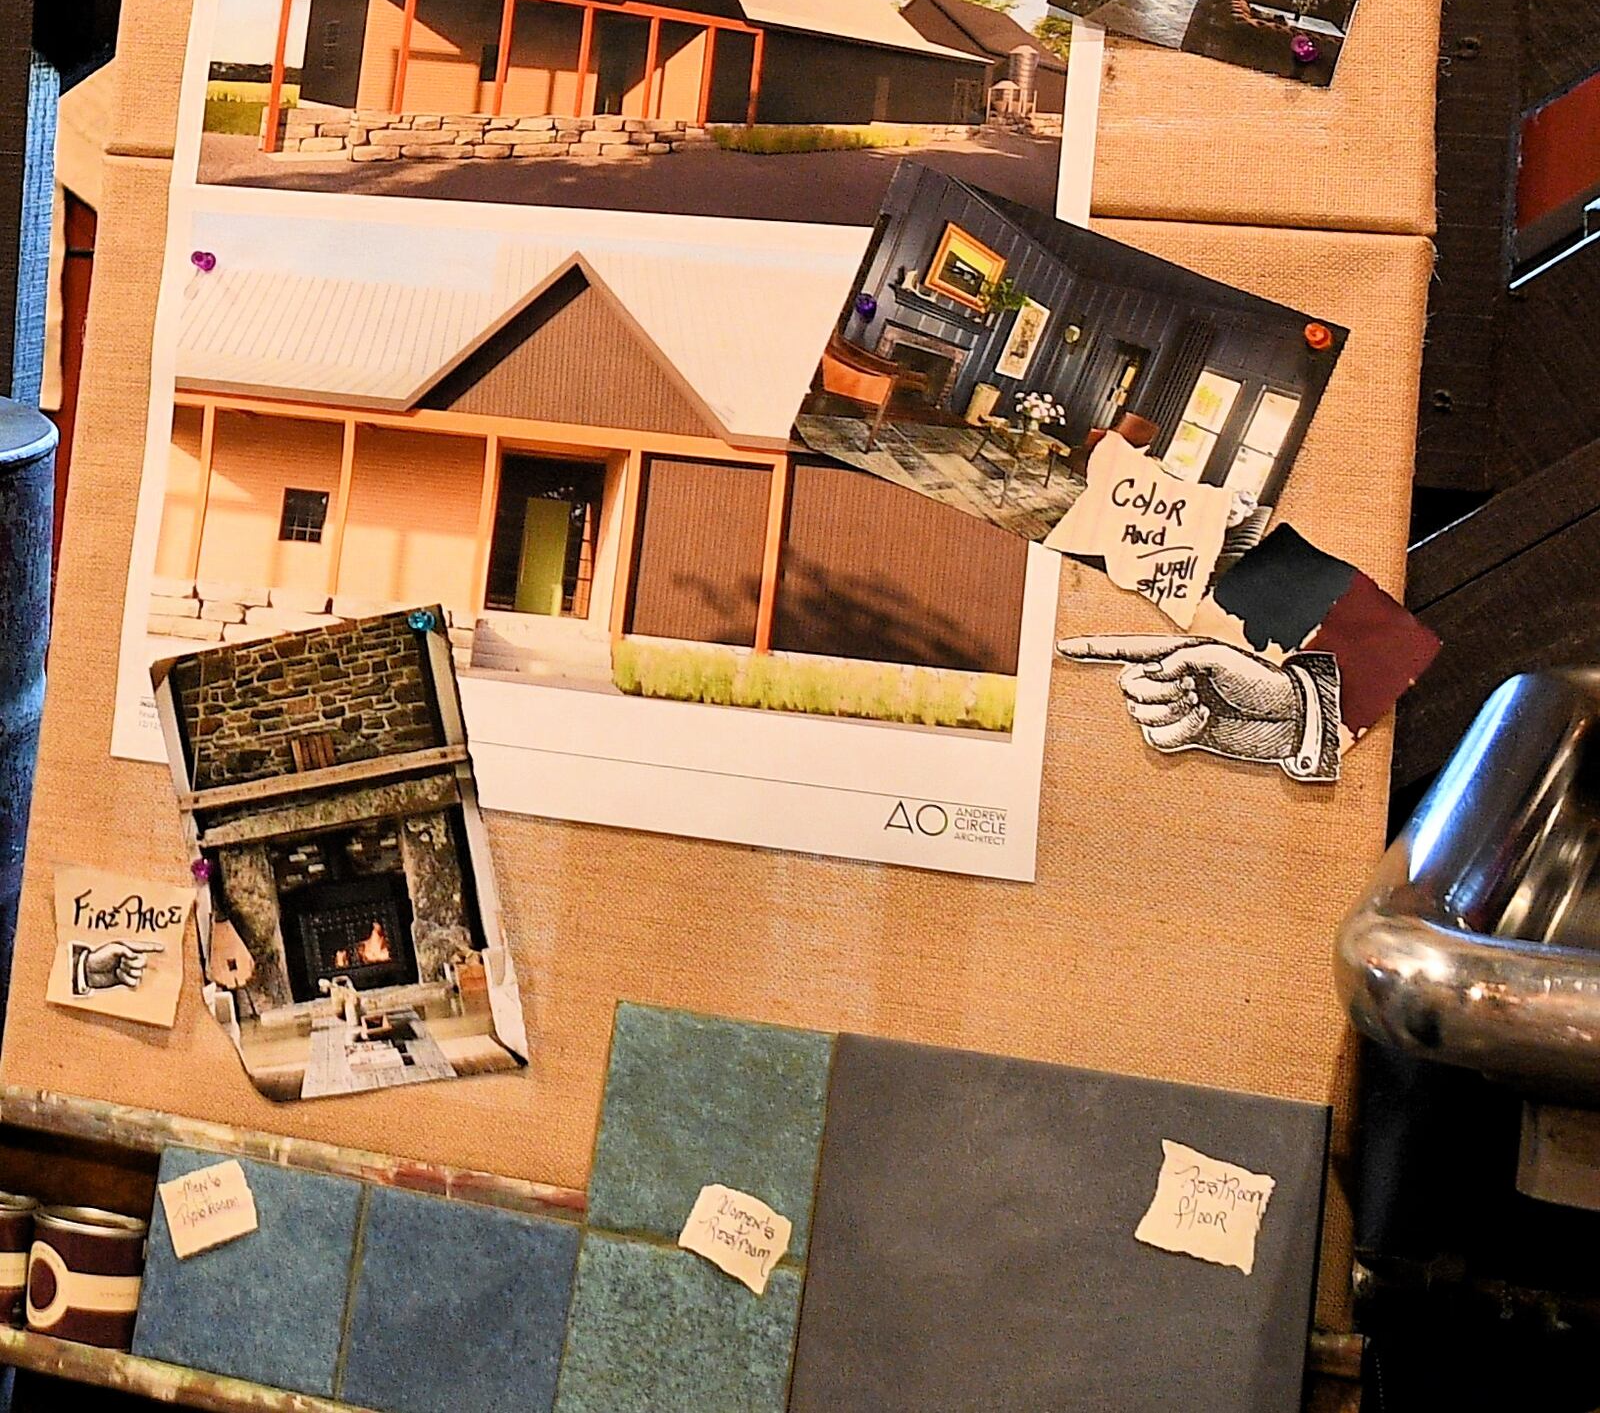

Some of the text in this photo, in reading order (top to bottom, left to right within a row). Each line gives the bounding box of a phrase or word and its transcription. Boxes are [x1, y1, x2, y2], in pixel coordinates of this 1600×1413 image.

[955, 807, 1006, 821] ANDREW
[954, 817, 1006, 835] CIRCLE
[954, 833, 1006, 845] ARCHITECT
